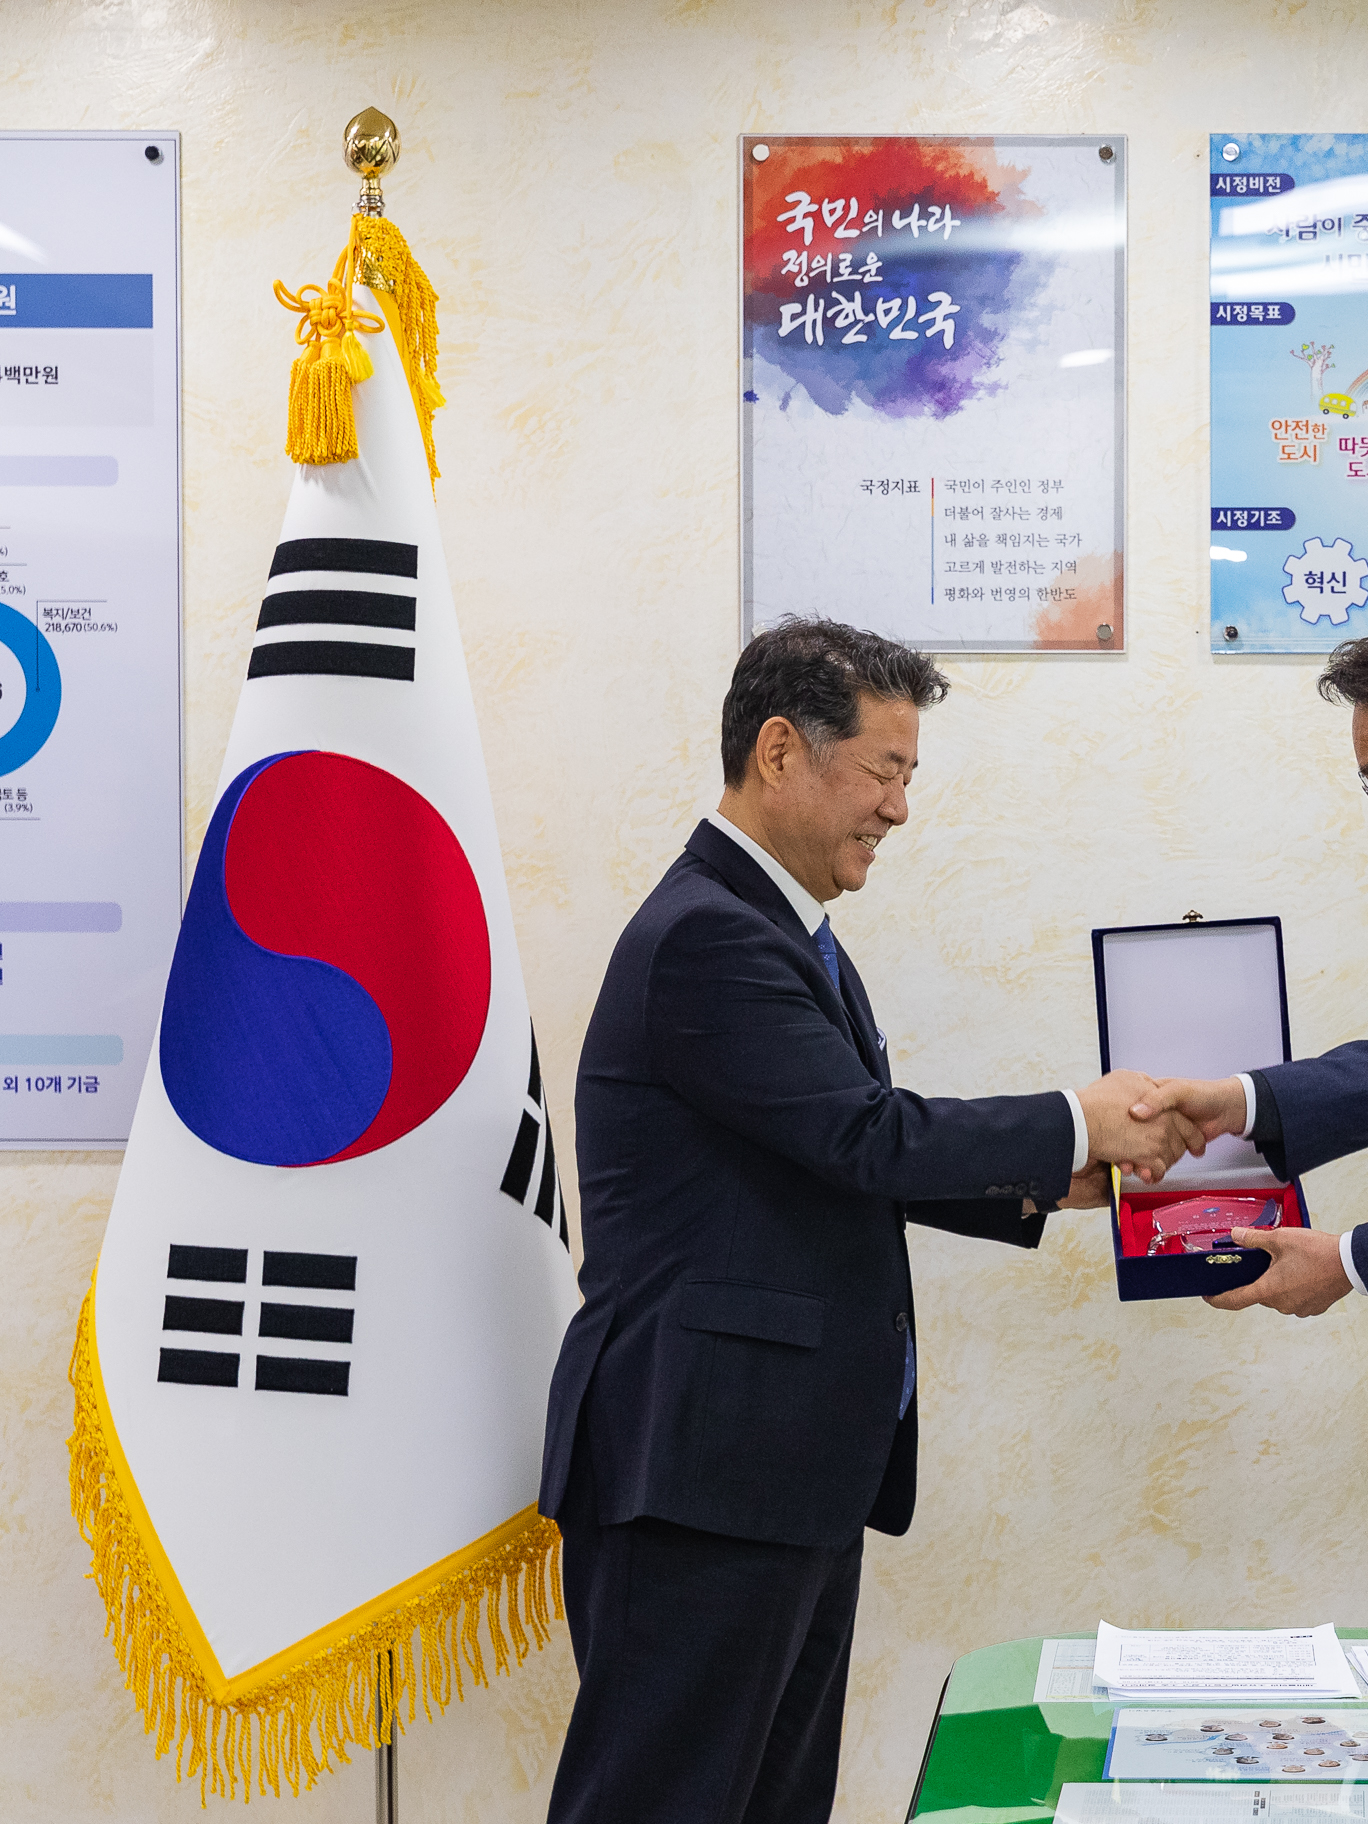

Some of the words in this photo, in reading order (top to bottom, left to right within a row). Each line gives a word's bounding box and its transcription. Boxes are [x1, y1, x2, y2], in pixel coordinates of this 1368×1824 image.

[1215, 176, 1281, 193] 시정비전
[776, 191, 884, 246] 국민의
[891, 203, 961, 240] 나라
[780, 248, 884, 288] 정의로운
[777, 290, 962, 350] 대한민국
[1215, 305, 1282, 322] 시정목표
[0, 365, 59, 385] 백만원
[1270, 419, 1327, 442] 안전한
[1279, 445, 1318, 462] 도시
[860, 479, 921, 496] 국정지표
[944, 479, 985, 494] 국민이
[990, 479, 1032, 494] 주인인
[1037, 479, 1065, 494] 정부
[944, 506, 984, 521] 더불어
[989, 506, 1031, 521] 잘사는
[1036, 506, 1063, 521] 경제
[1216, 510, 1283, 527] 시정기조
[944, 533, 957, 548] 내
[962, 533, 990, 548] 삶을
[995, 533, 1050, 548] 책임지는
[1054, 533, 1083, 548] 국가
[944, 560, 985, 575] 고르게
[990, 560, 1046, 575] 발전하는
[1051, 560, 1077, 575] 지역
[1304, 571, 1348, 595] 혁신
[944, 587, 985, 602] 평화와
[990, 587, 1031, 602] 번영의
[1036, 587, 1078, 602] 한반도
[42, 607, 92, 621] 복지/보건
[16, 788, 28, 801] 등
[4, 803, 34, 813] (3.9%)
[2, 1075, 19, 1094] 외
[25, 1075, 62, 1094] 10개
[67, 1075, 101, 1094] 기금
